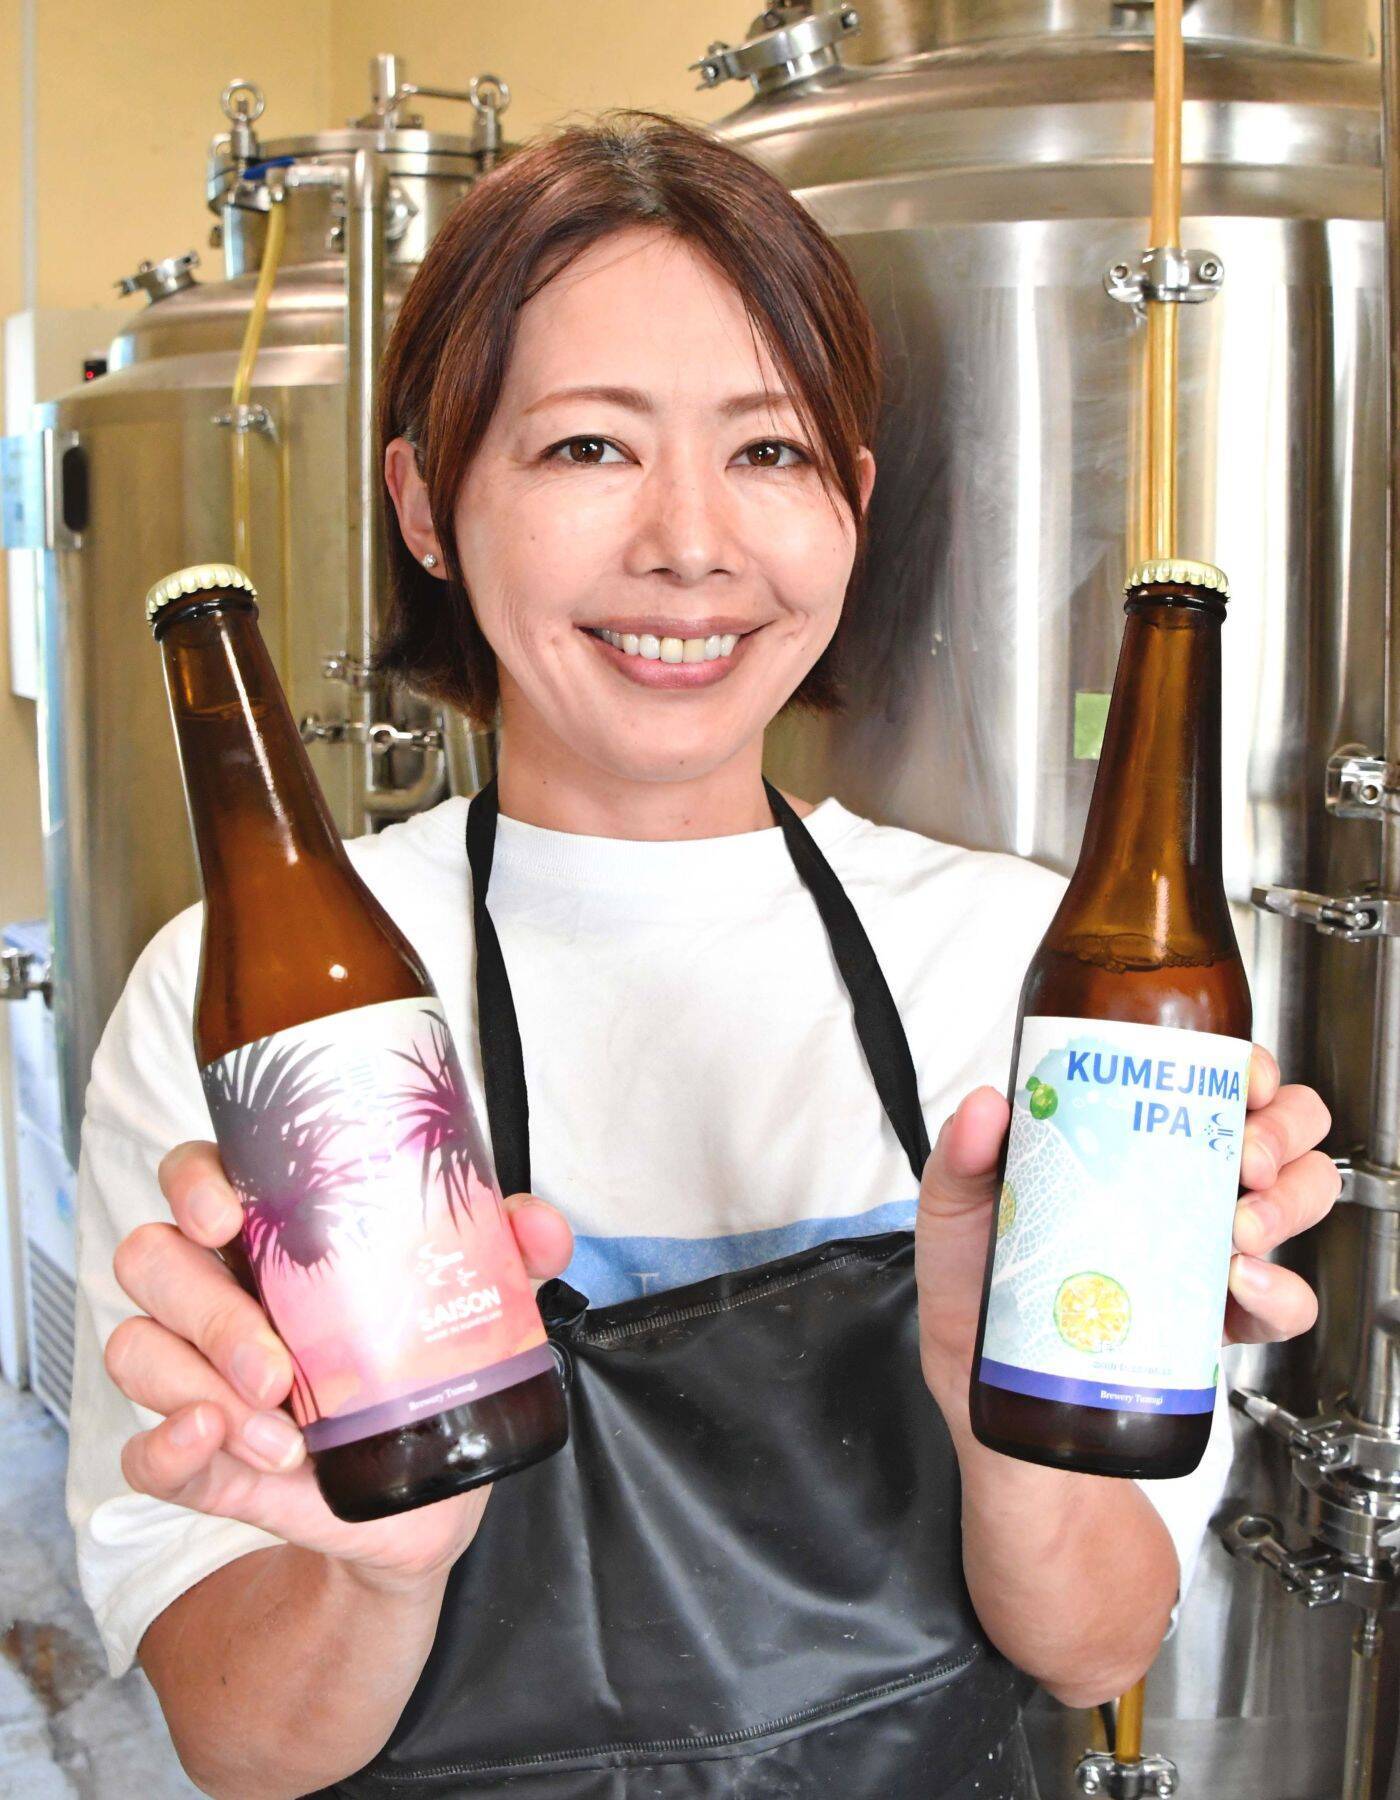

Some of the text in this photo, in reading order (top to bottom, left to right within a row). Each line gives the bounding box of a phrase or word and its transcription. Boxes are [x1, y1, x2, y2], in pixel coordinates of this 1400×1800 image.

[1066, 1050, 1240, 1101] KUMEJIMA
[1132, 1100, 1192, 1138] IPA
[417, 1284, 502, 1332] SAISON
[1100, 1389, 1135, 1404] Brewery
